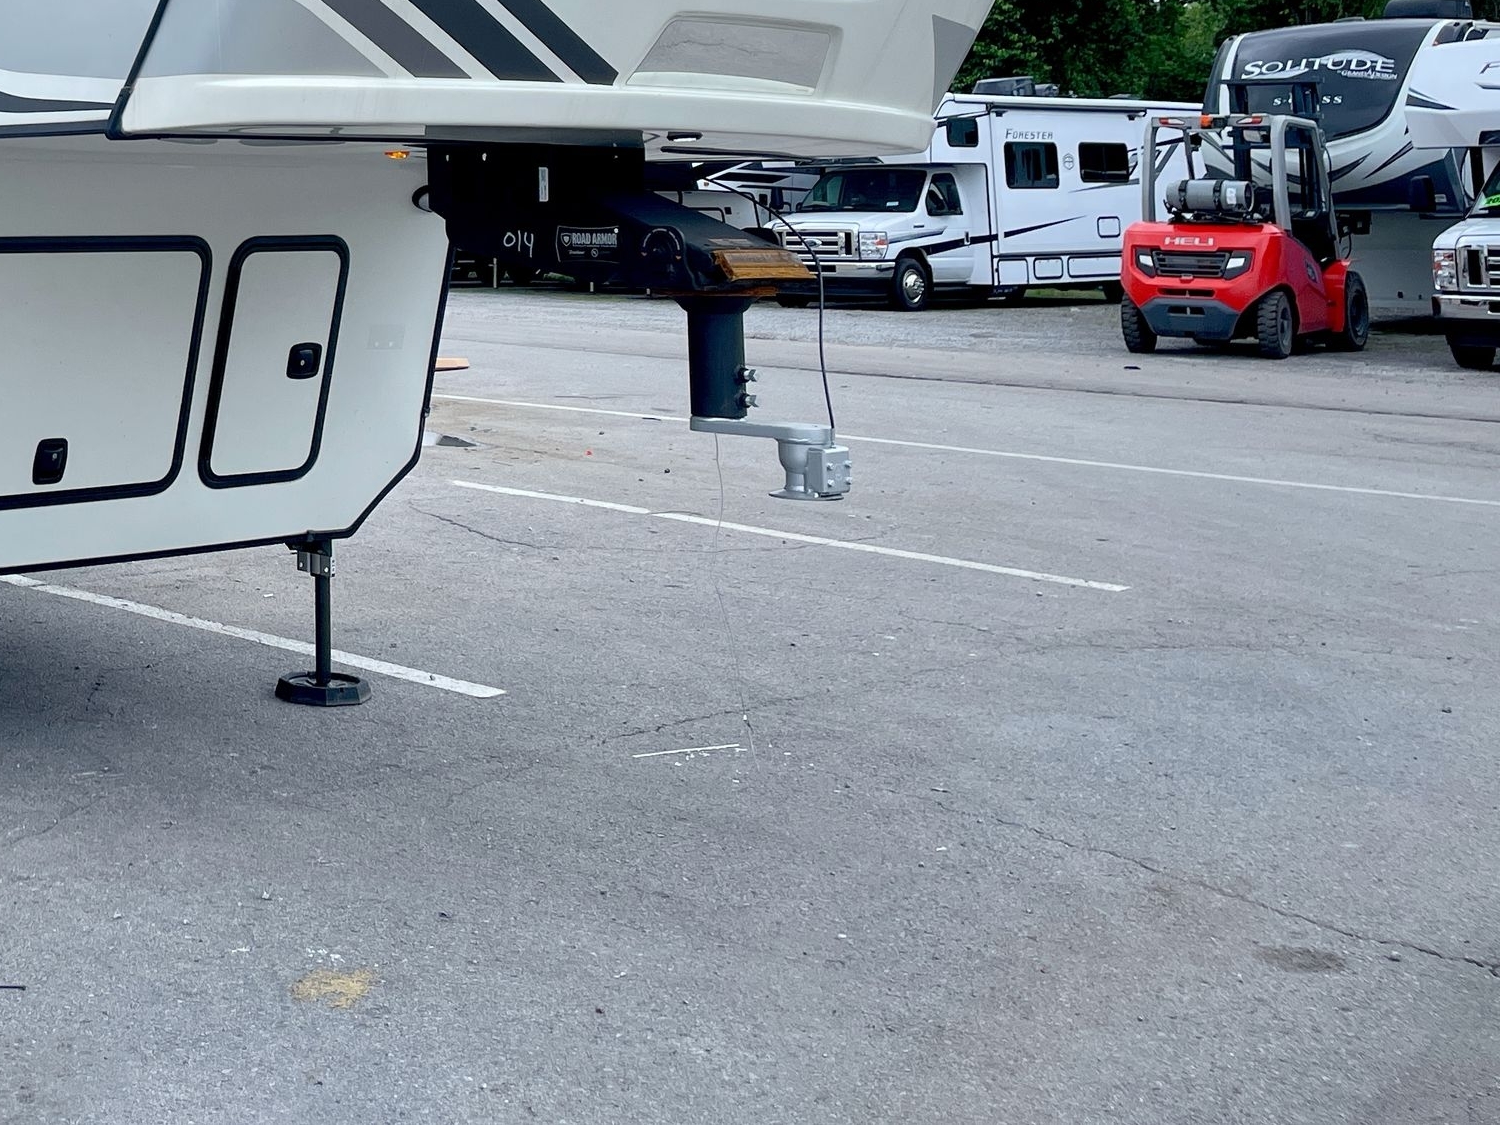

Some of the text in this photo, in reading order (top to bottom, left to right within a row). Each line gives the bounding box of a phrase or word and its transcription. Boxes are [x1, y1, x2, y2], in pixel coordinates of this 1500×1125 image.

[1241, 57, 1395, 80] SOLITUDE
[503, 230, 534, 258] 014
[572, 233, 617, 245] ROAD ARMOR
[1164, 236, 1214, 246] HELI
